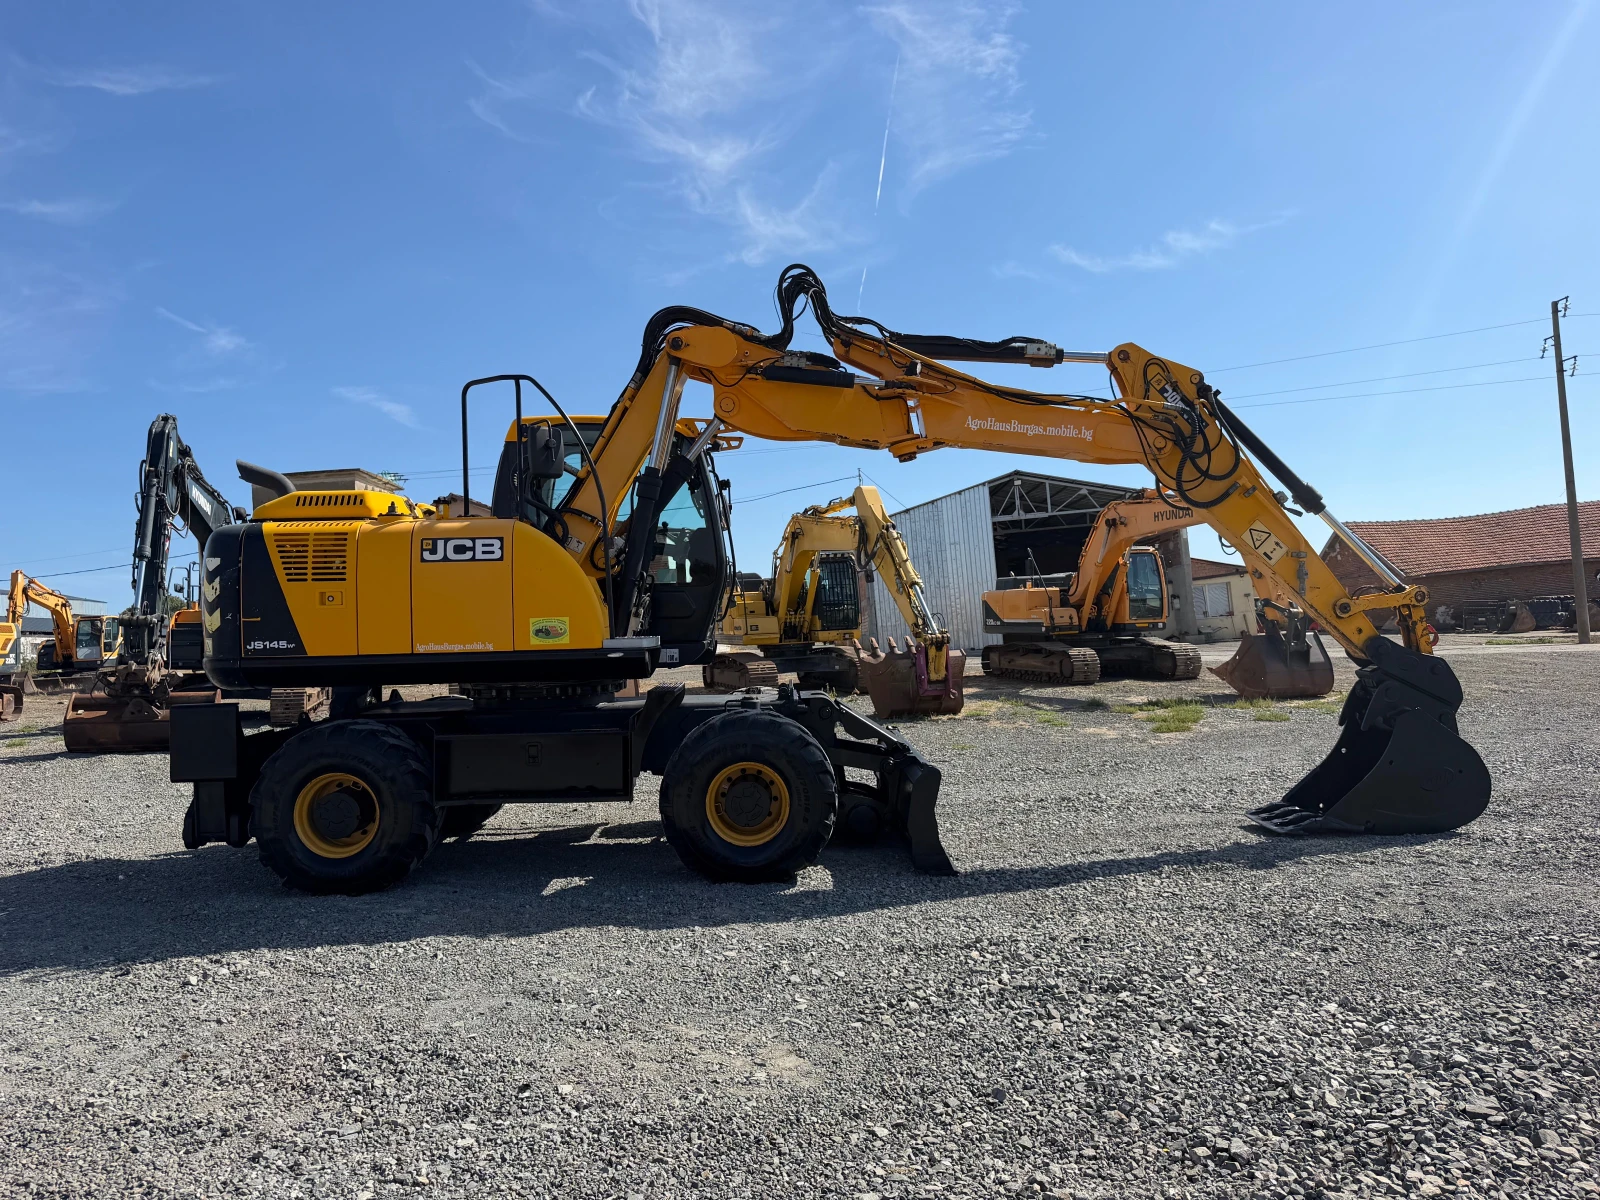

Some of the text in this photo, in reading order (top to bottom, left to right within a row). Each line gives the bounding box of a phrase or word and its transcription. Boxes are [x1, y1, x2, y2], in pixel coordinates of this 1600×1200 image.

[964, 415, 1094, 441] AgroHausBurgas.mobile.bg
[1153, 508, 1194, 522] HYUNDAI
[423, 538, 502, 561] JCB
[415, 642, 494, 652] AgroHausBurgas.mobile.bg
